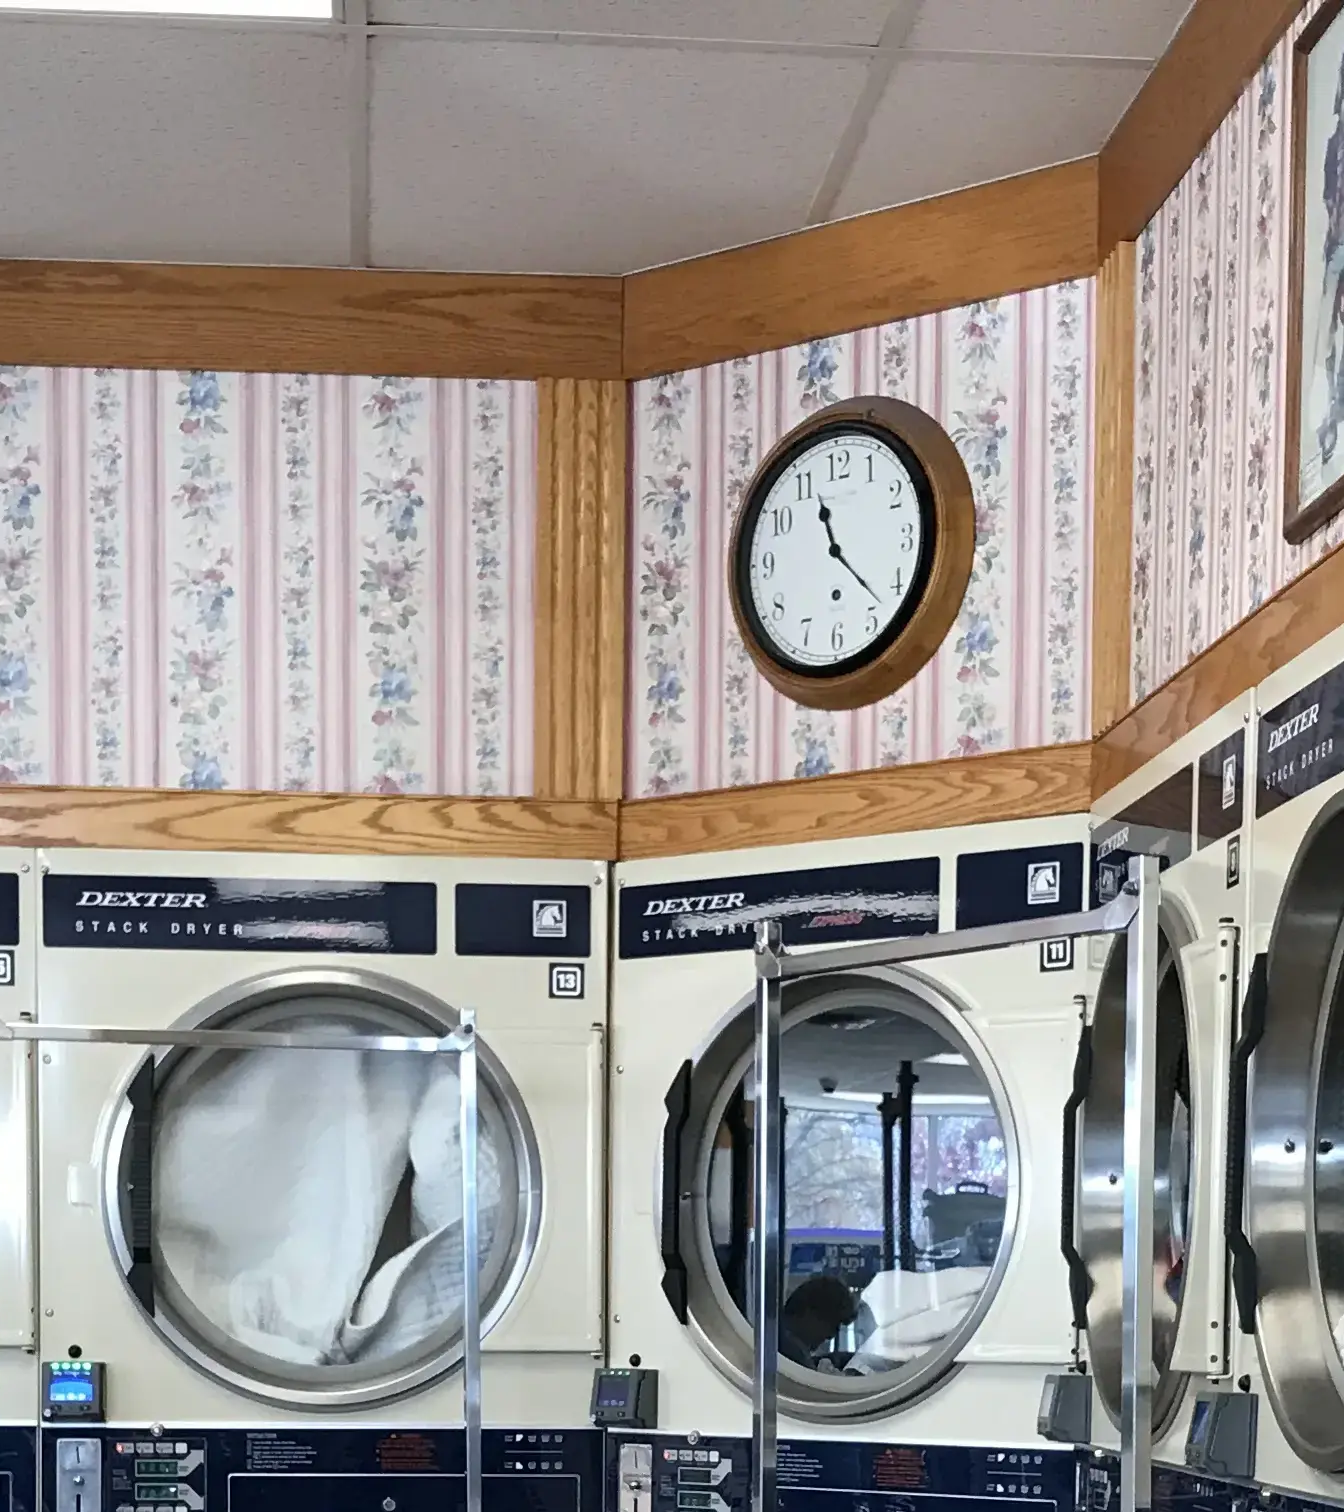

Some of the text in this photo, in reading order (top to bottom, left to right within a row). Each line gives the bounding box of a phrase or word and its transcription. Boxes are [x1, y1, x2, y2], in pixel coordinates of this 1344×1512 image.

[825, 449, 850, 482] 12
[864, 454, 875, 483] 1
[795, 471, 812, 501] 11
[889, 479, 902, 509] 2
[770, 506, 792, 537] 10
[901, 523, 913, 553] 3
[762, 552, 775, 580] 9
[890, 567, 903, 596] 4
[771, 592, 785, 621] 8
[865, 606, 878, 635] 5
[801, 617, 812, 646] 7
[831, 622, 843, 651] 6
[1267, 703, 1320, 753] DEXTER
[1265, 738, 1333, 790] STACK DRYER
[76, 891, 207, 908] DEXTER
[643, 892, 745, 916] DEXTER
[75, 920, 243, 936] STACK DRYER
[642, 926, 698, 942] STACK
[1049, 943, 1066, 960] 11
[557, 973, 576, 989] 13
